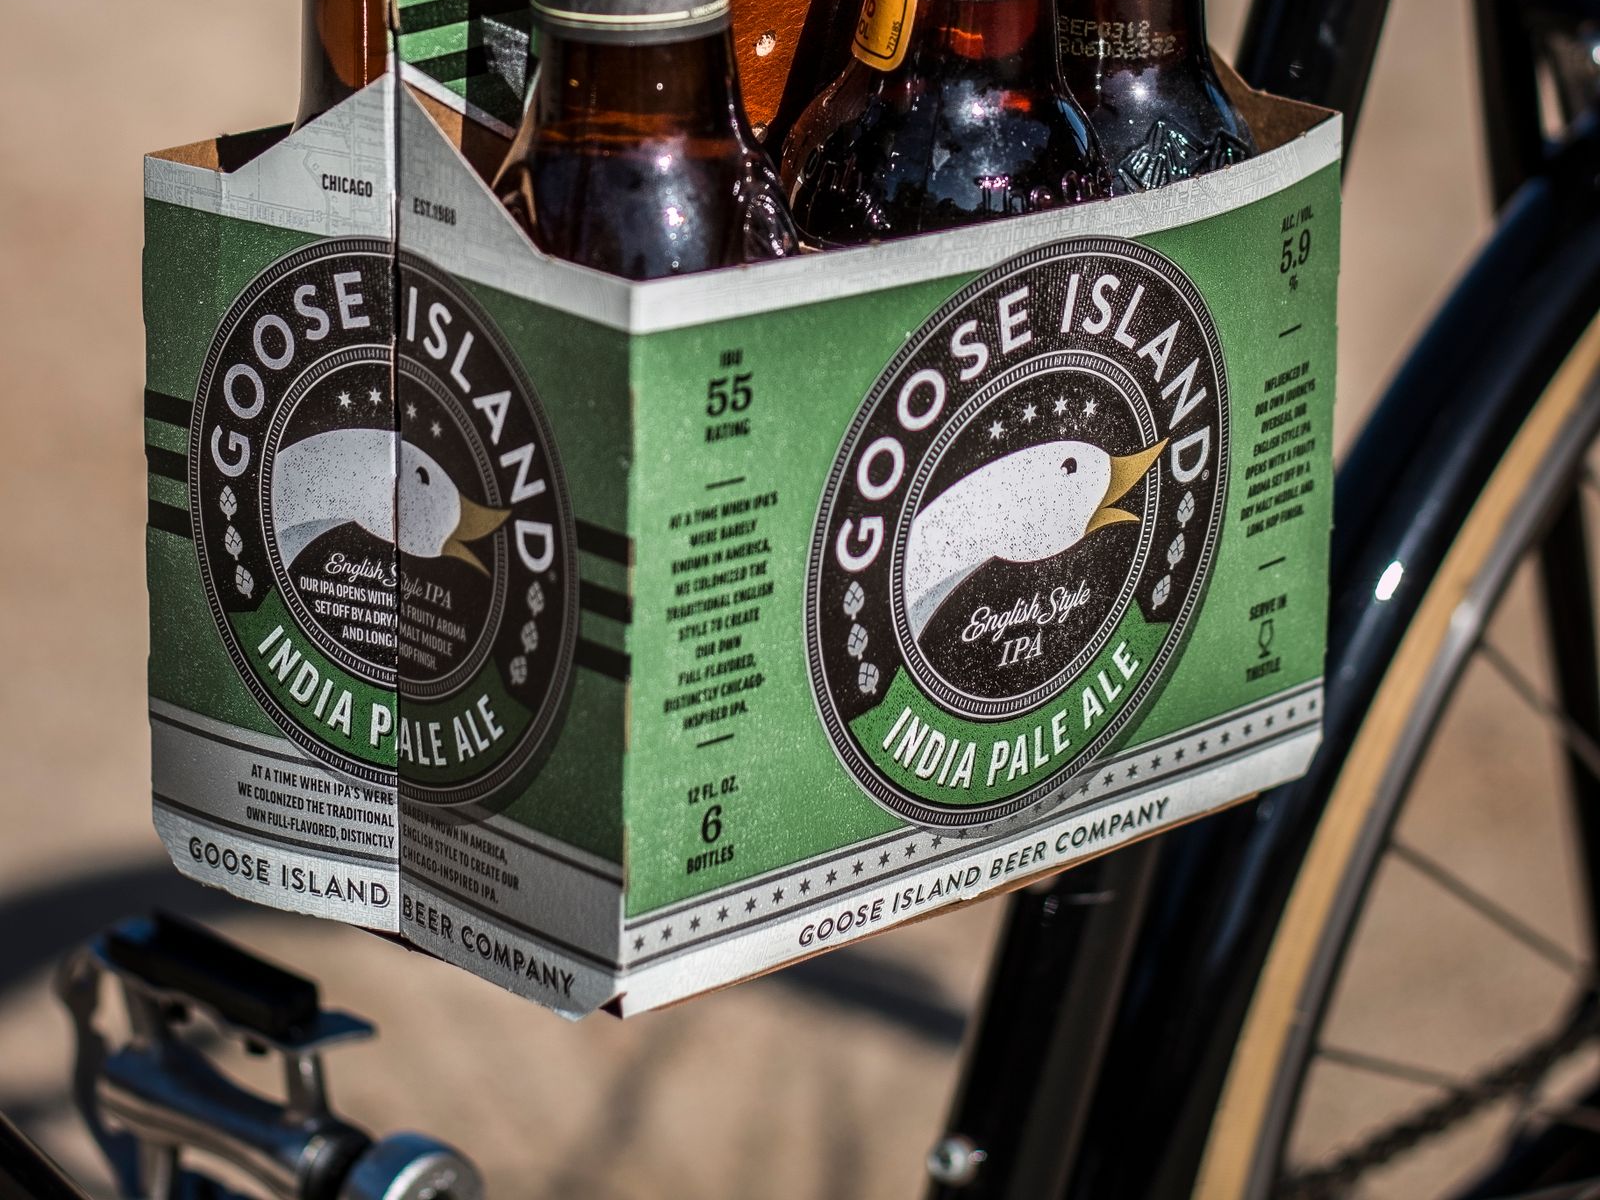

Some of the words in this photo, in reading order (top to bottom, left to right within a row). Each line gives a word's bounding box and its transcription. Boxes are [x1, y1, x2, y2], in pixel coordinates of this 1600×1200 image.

[322, 174, 373, 197] CHICAGO
[1279, 228, 1311, 274] 5.9
[211, 271, 370, 477] GOOSE
[406, 287, 554, 572] ISLAND
[705, 371, 753, 417] 55
[836, 287, 1032, 572] GOOSE
[1060, 273, 1210, 484] ISLAND
[300, 576, 318, 592] OUR
[320, 581, 335, 595] IPA
[337, 584, 366, 601] OPENS
[368, 590, 393, 607] WITH
[407, 605, 434, 628] FRUITY
[437, 618, 466, 641] AROMA
[325, 553, 384, 582] English
[425, 582, 452, 609] IPA
[315, 600, 331, 615] SET
[333, 603, 350, 618] OFF
[352, 607, 364, 621] BY
[365, 610, 372, 624] A
[374, 611, 392, 626] DRY
[422, 631, 453, 657] MIDDLE
[342, 625, 363, 640] AND
[366, 630, 392, 647] LONG
[963, 599, 1041, 642] English
[1039, 583, 1091, 631] Style
[999, 632, 1044, 667] IPA
[258, 624, 353, 738] INDIA
[370, 702, 447, 767] PALE
[456, 694, 504, 763] ALE
[882, 706, 976, 791] INDIA
[986, 717, 1072, 786] PALE
[1082, 640, 1141, 728] ALE
[251, 764, 262, 778] AT
[264, 767, 271, 781] A
[274, 770, 297, 787] TIME
[300, 775, 330, 794] WHEN
[334, 782, 360, 799] IPA'S
[363, 788, 394, 805] WERE
[402, 802, 429, 825] BARELY
[430, 817, 458, 840] KNOWN
[460, 830, 468, 845] IN
[470, 834, 507, 865] AMERICA,
[688, 786, 700, 805] 12
[702, 781, 718, 800] FL.
[238, 781, 252, 797] WE
[254, 786, 304, 810] COLONIZED
[306, 798, 324, 814] THE
[326, 803, 394, 827] TRADITIONAL
[402, 823, 433, 850] ENGLISH
[435, 840, 457, 861] STYLE
[460, 851, 469, 867] TO
[471, 857, 500, 882] CREATE
[502, 871, 519, 890] OUR
[246, 806, 266, 822] OWN
[268, 812, 339, 841] FULL-FLAVORED,
[341, 827, 395, 849] DISTINCTLY
[402, 845, 479, 894] CHICAGO-INSPIRED
[701, 804, 722, 843] 6
[686, 844, 735, 875] BOTTLES
[798, 898, 883, 947] GOOSE
[892, 866, 981, 913] ISLAND
[989, 842, 1046, 881] BEER
[1056, 797, 1170, 853] COMPANY
[189, 836, 270, 884] GOOSE
[281, 864, 390, 908] ISLAND
[402, 893, 453, 942] BEER
[461, 926, 574, 996] COMPANY
